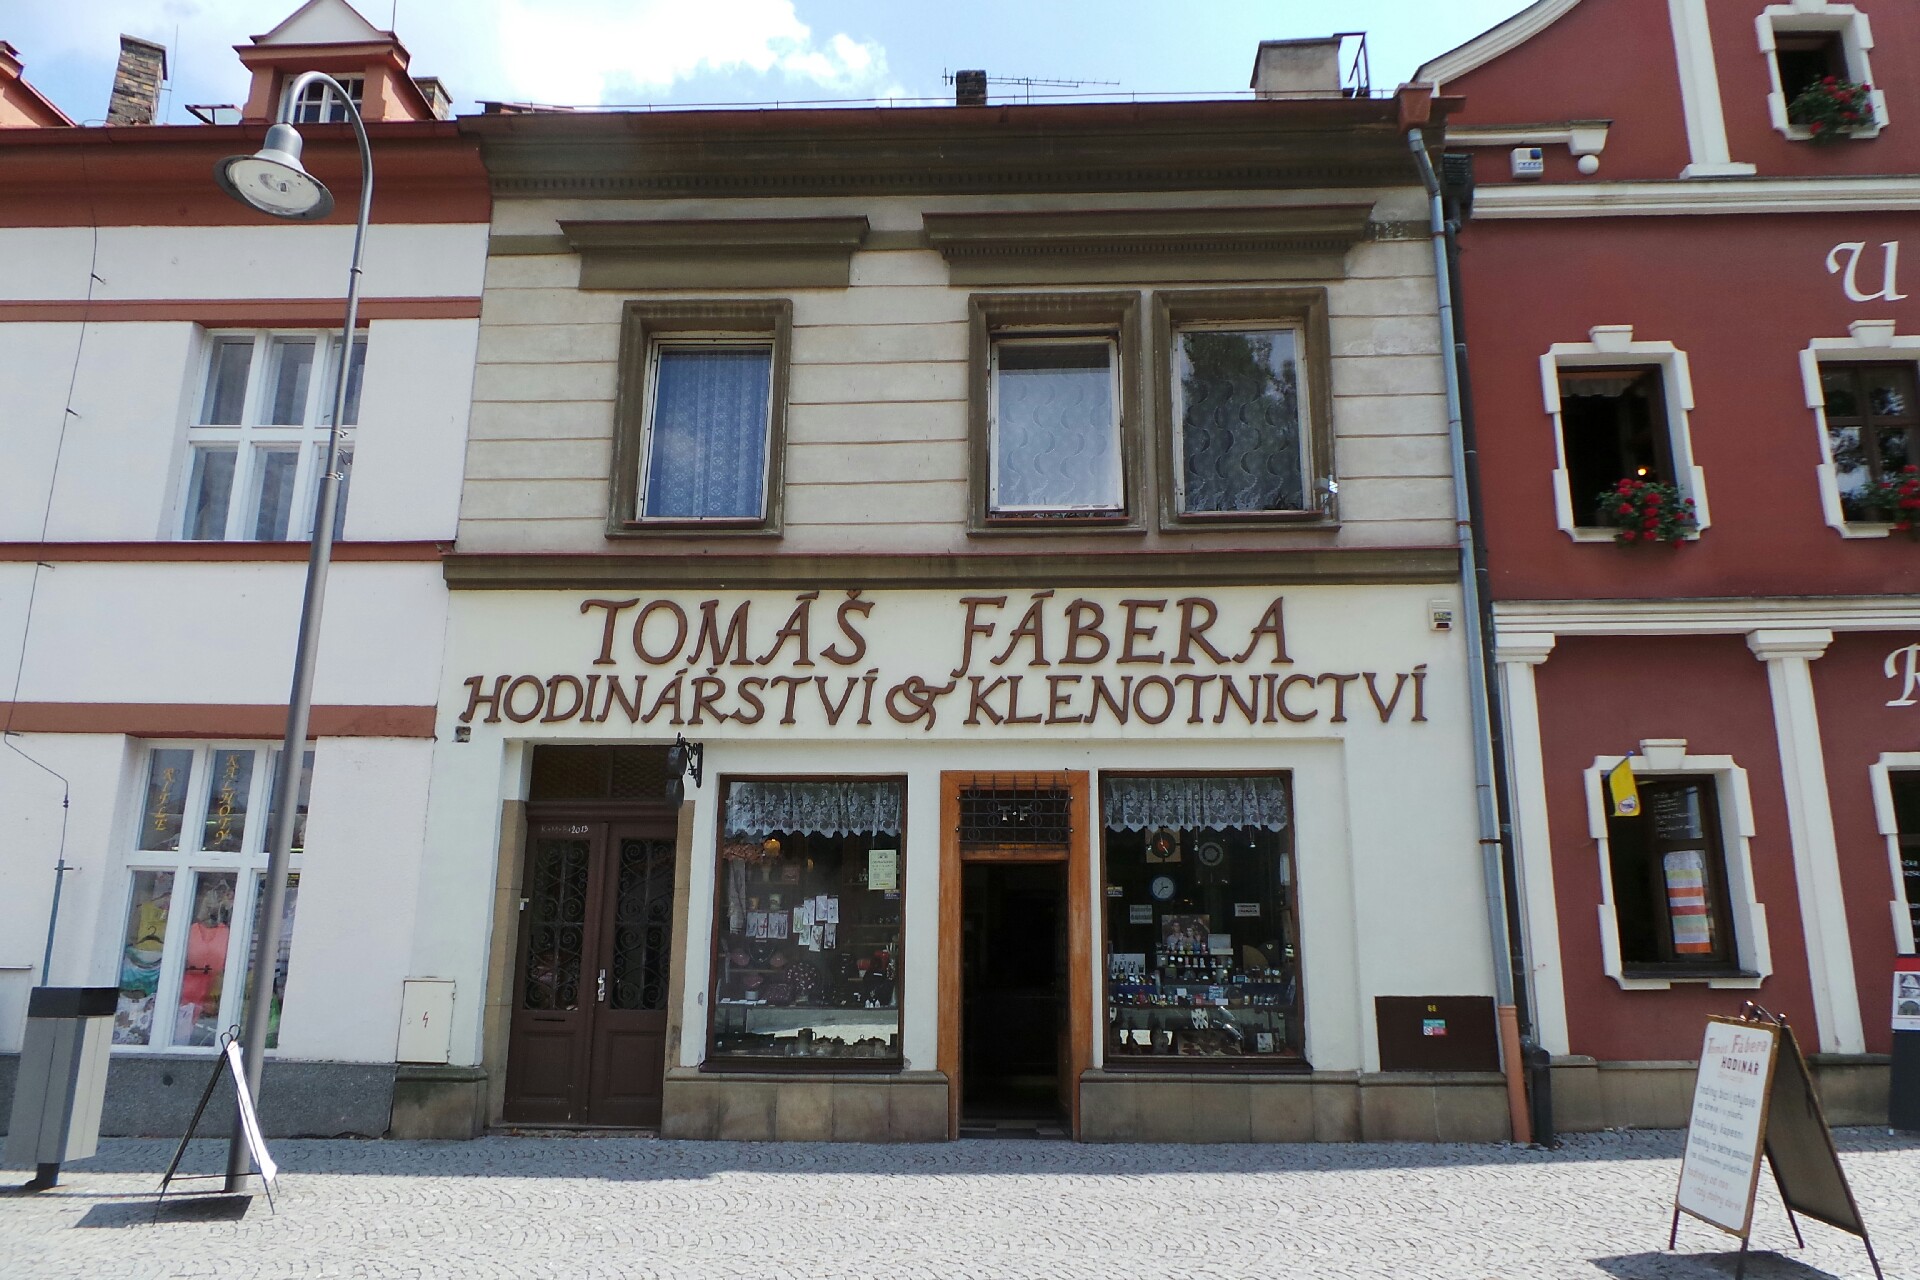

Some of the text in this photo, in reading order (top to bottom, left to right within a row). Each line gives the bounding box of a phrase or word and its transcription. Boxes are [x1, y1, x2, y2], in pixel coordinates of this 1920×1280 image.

[580, 589, 1294, 678] TOMÁŠ FÁBERA
[459, 664, 1428, 731] HODINÁŘSTVÍ & KLENOTNICTVÍ
[214, 754, 240, 845] KALHOTY
